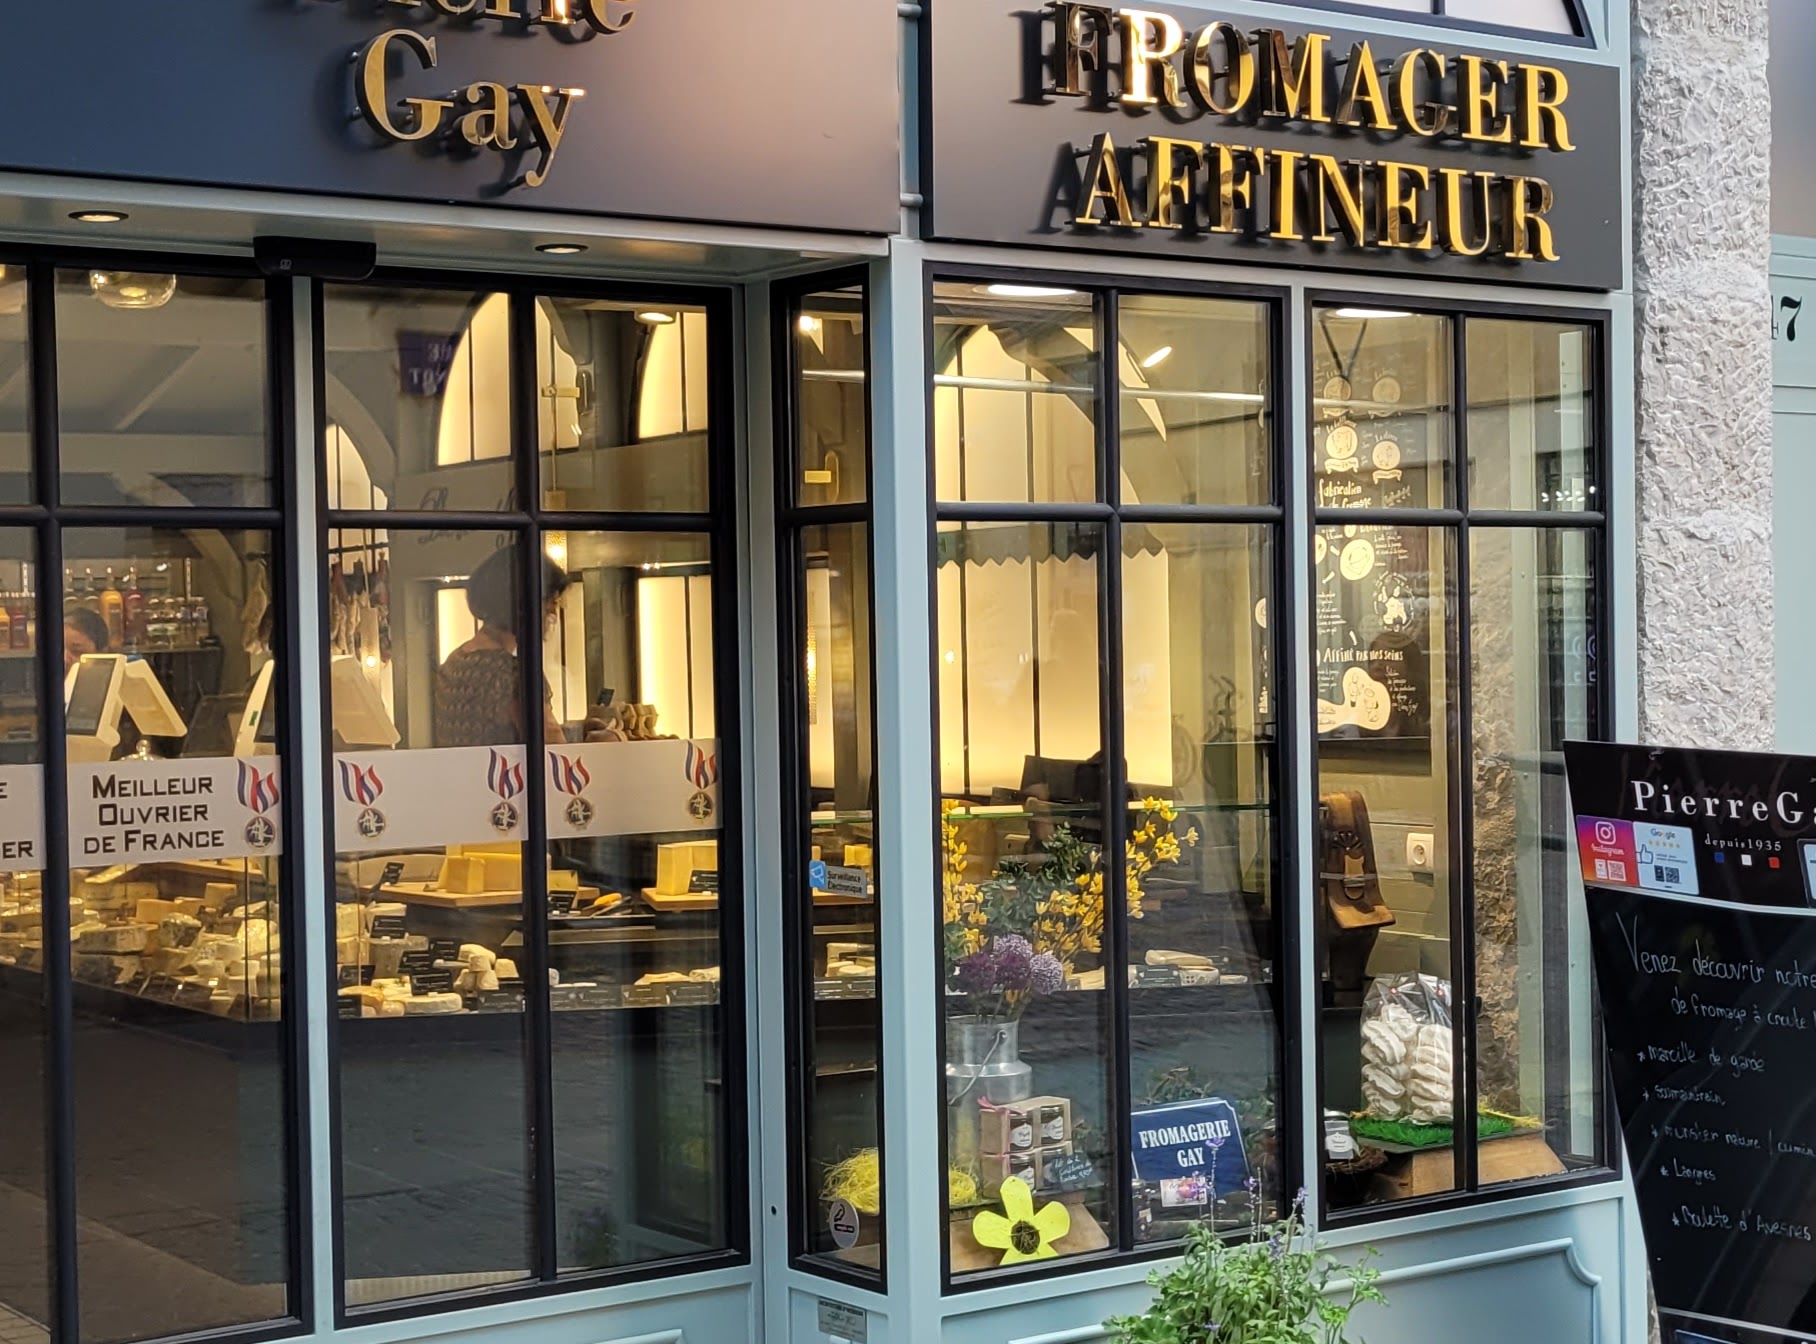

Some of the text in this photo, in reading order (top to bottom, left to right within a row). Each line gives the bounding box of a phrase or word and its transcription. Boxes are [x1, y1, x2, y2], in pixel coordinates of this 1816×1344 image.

[354, 28, 586, 188] Gay
[1073, 131, 1561, 263] AFFINEUR
[92, 774, 214, 799] MEILLEUR
[99, 803, 208, 826] OUVRIER
[84, 829, 225, 854] DE FRANCE
[1615, 911, 1683, 975] Venez
[1671, 985, 1688, 1015] de
[1138, 1119, 1231, 1149] FROMAGERIE
[1176, 1147, 1206, 1168] GAY
